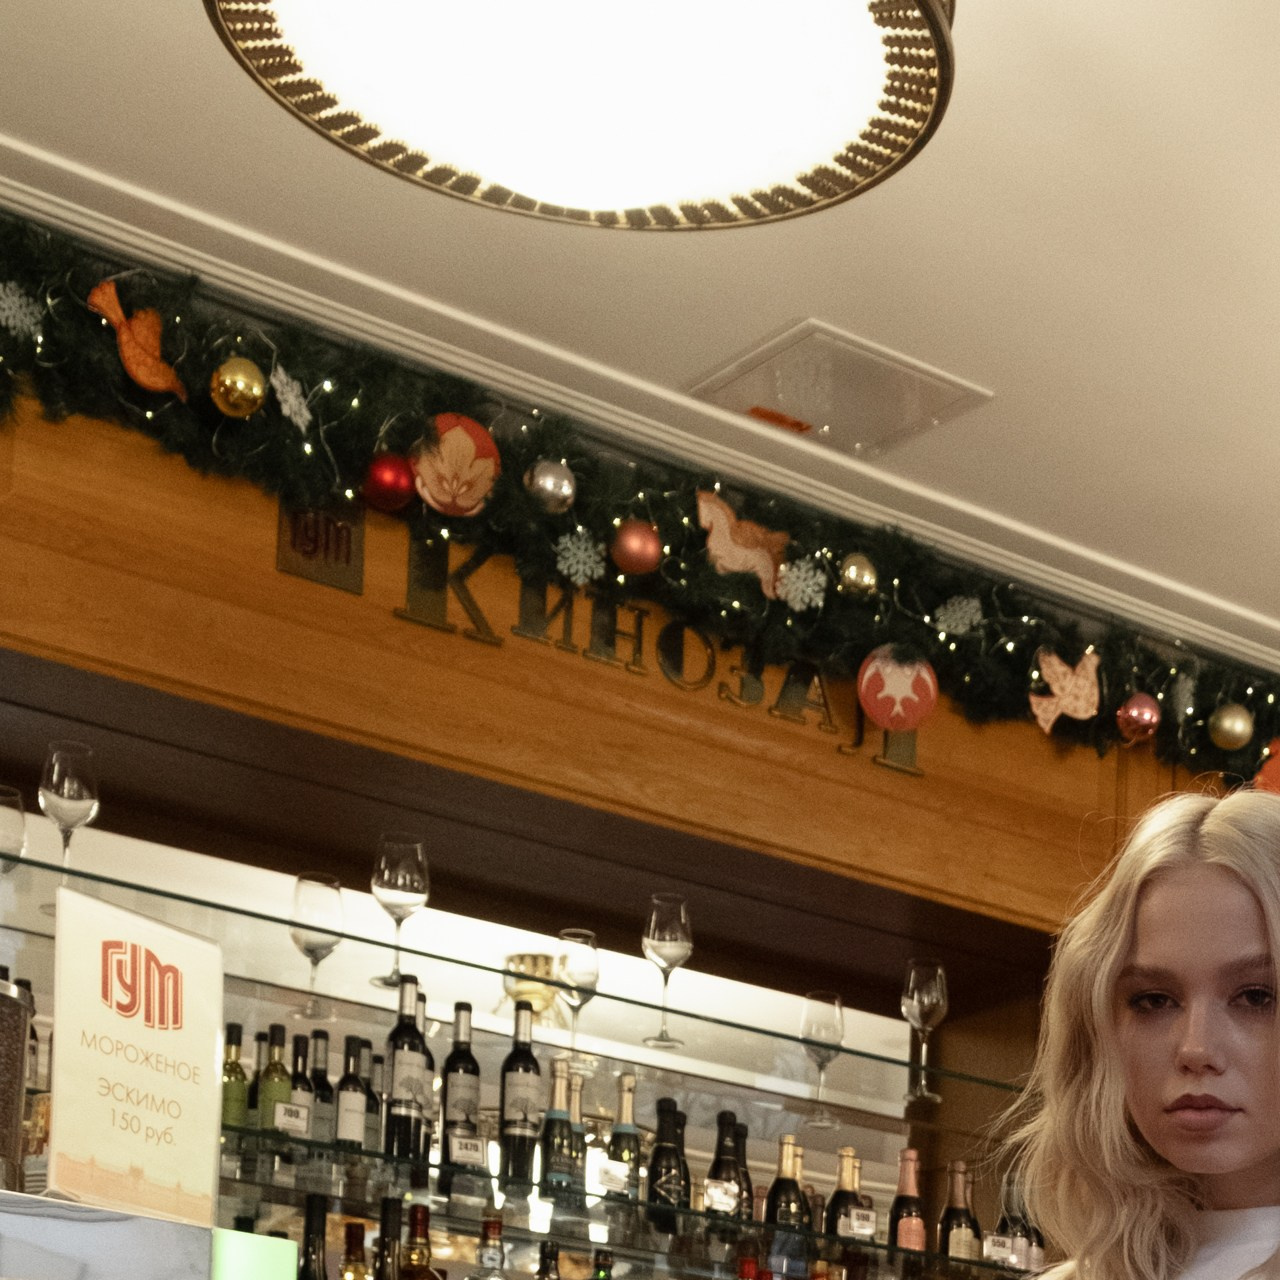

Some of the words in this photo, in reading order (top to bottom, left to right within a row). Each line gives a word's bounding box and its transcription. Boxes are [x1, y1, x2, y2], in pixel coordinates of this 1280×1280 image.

[101, 940, 183, 1031] ГУМ
[80, 1029, 201, 1085] МОРОЖЕНОЕ
[97, 1077, 182, 1120] ЭСКИМО
[110, 1108, 141, 1134] 150
[145, 1126, 176, 1147] руб.
